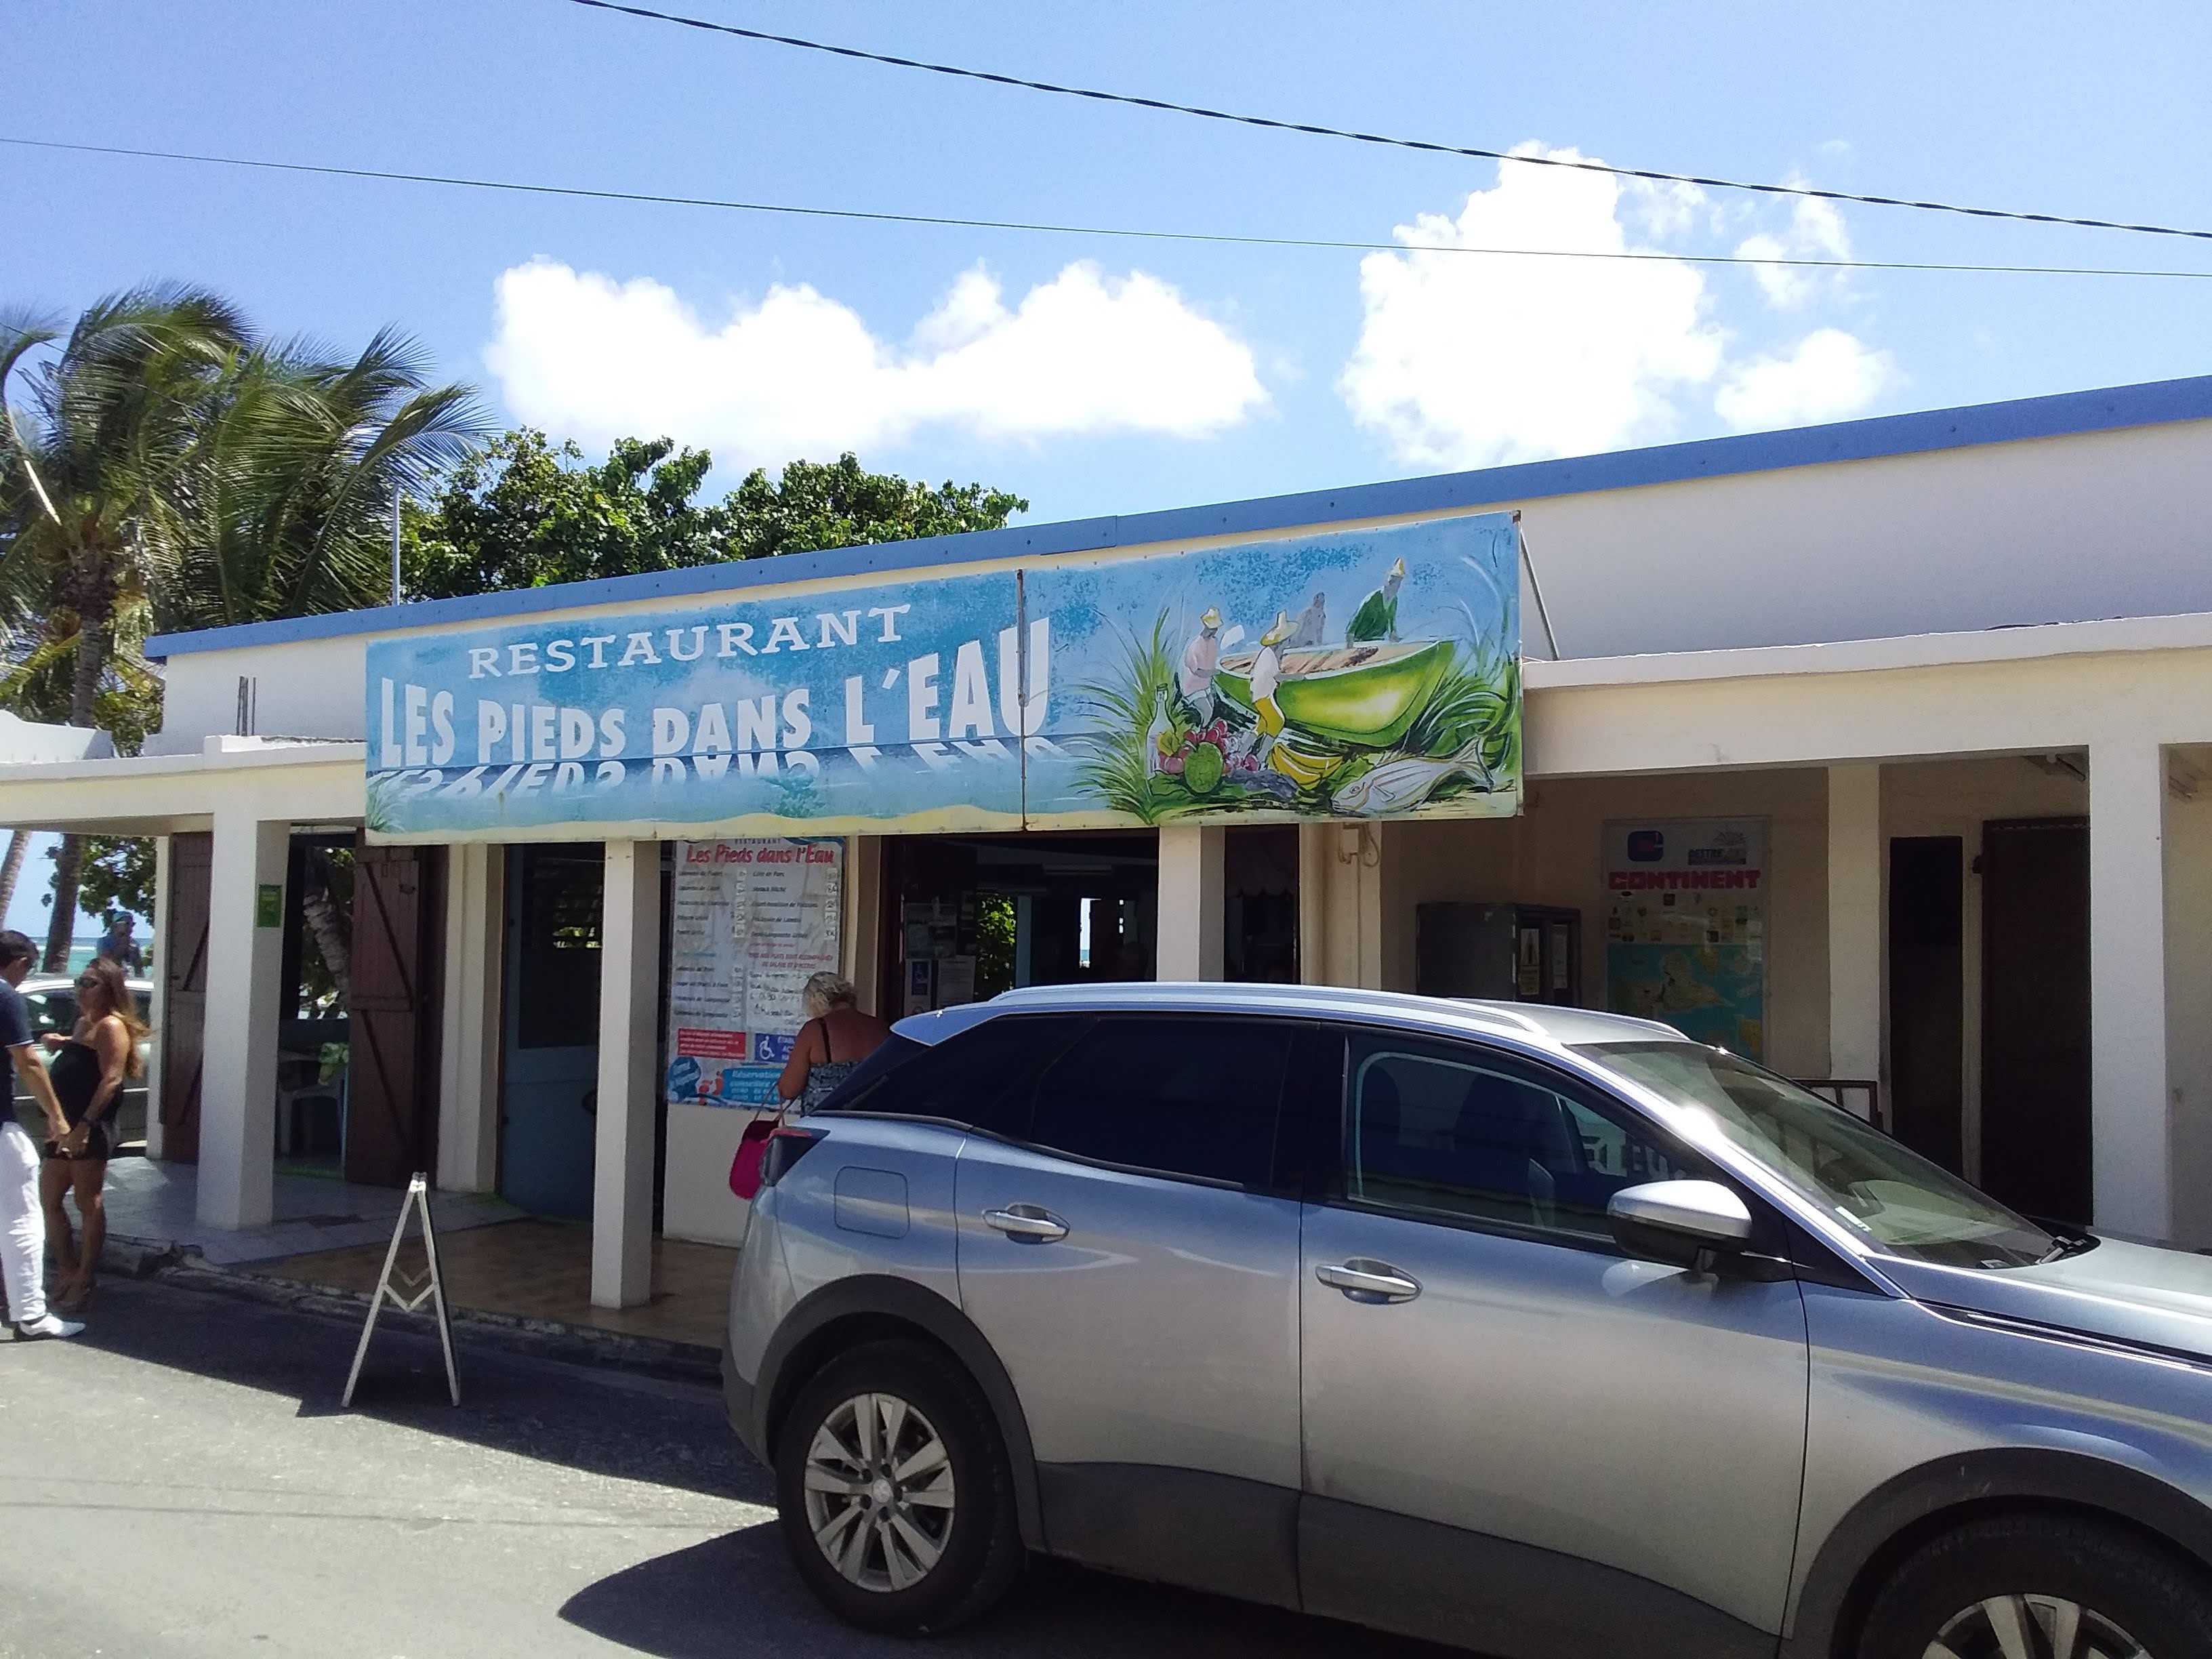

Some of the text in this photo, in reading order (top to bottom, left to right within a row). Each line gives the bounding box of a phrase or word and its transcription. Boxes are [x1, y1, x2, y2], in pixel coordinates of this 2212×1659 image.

[469, 605, 911, 679] RESTAURANT
[381, 678, 455, 768] LES
[478, 699, 626, 764] PIEDS
[653, 689, 811, 755] DANS
[687, 844, 834, 863] Les Pieds dans l'Eau
[1610, 870, 1760, 889] CONTINENT
